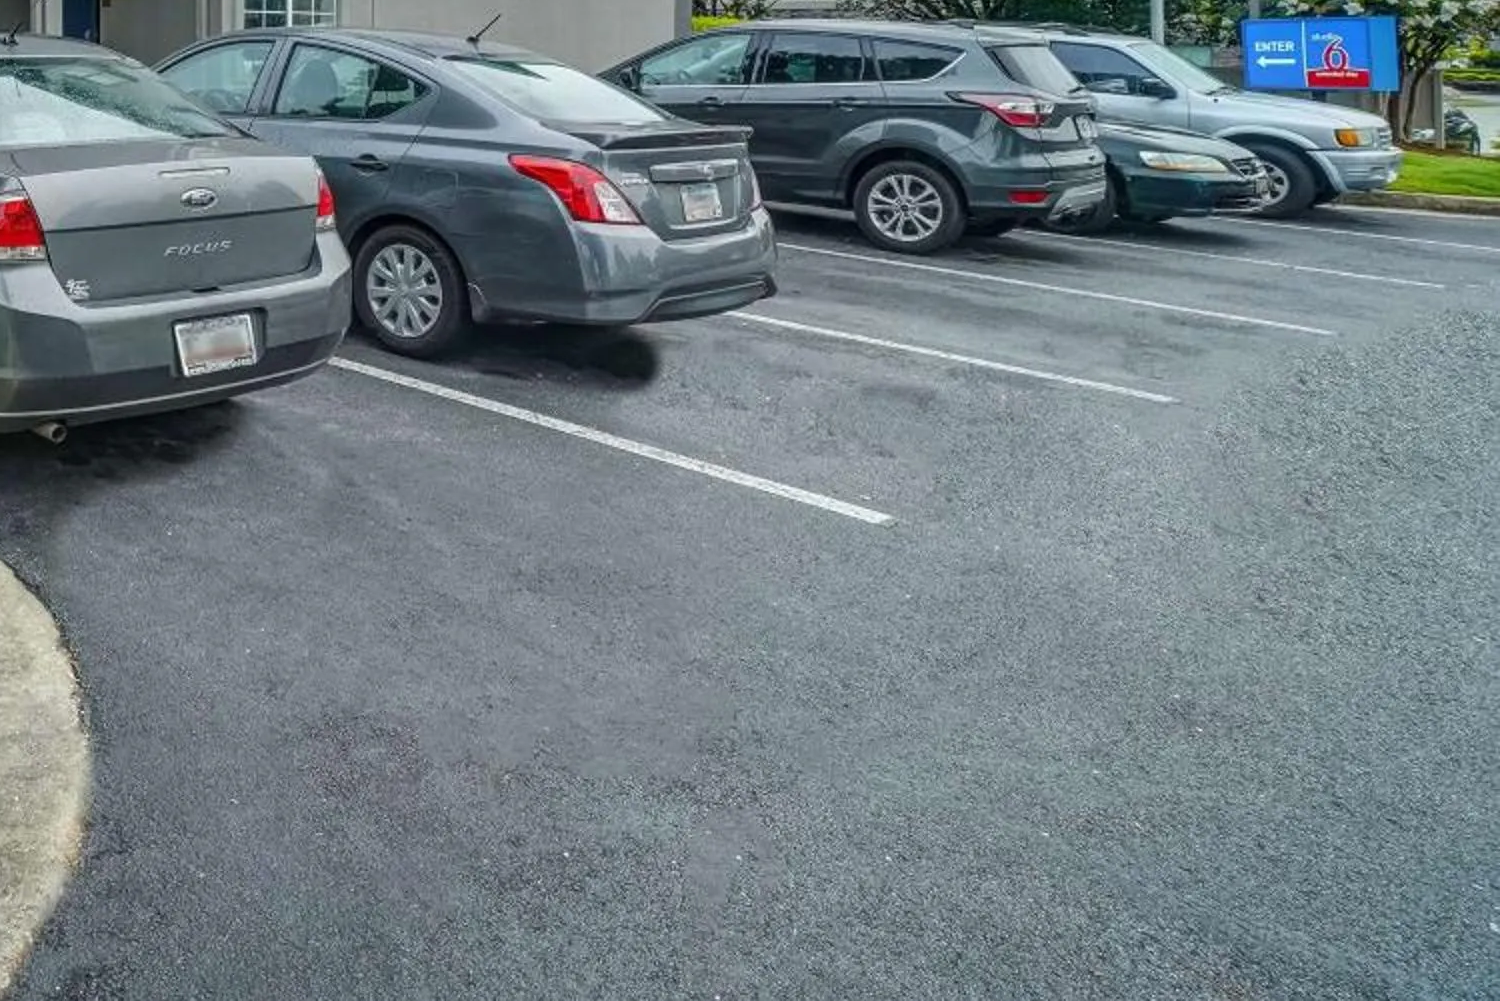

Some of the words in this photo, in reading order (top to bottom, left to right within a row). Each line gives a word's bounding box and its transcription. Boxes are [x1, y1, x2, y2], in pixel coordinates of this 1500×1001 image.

[1255, 41, 1295, 52] ENTER
[1322, 35, 1348, 70] 6
[163, 240, 232, 257] FOCUS
